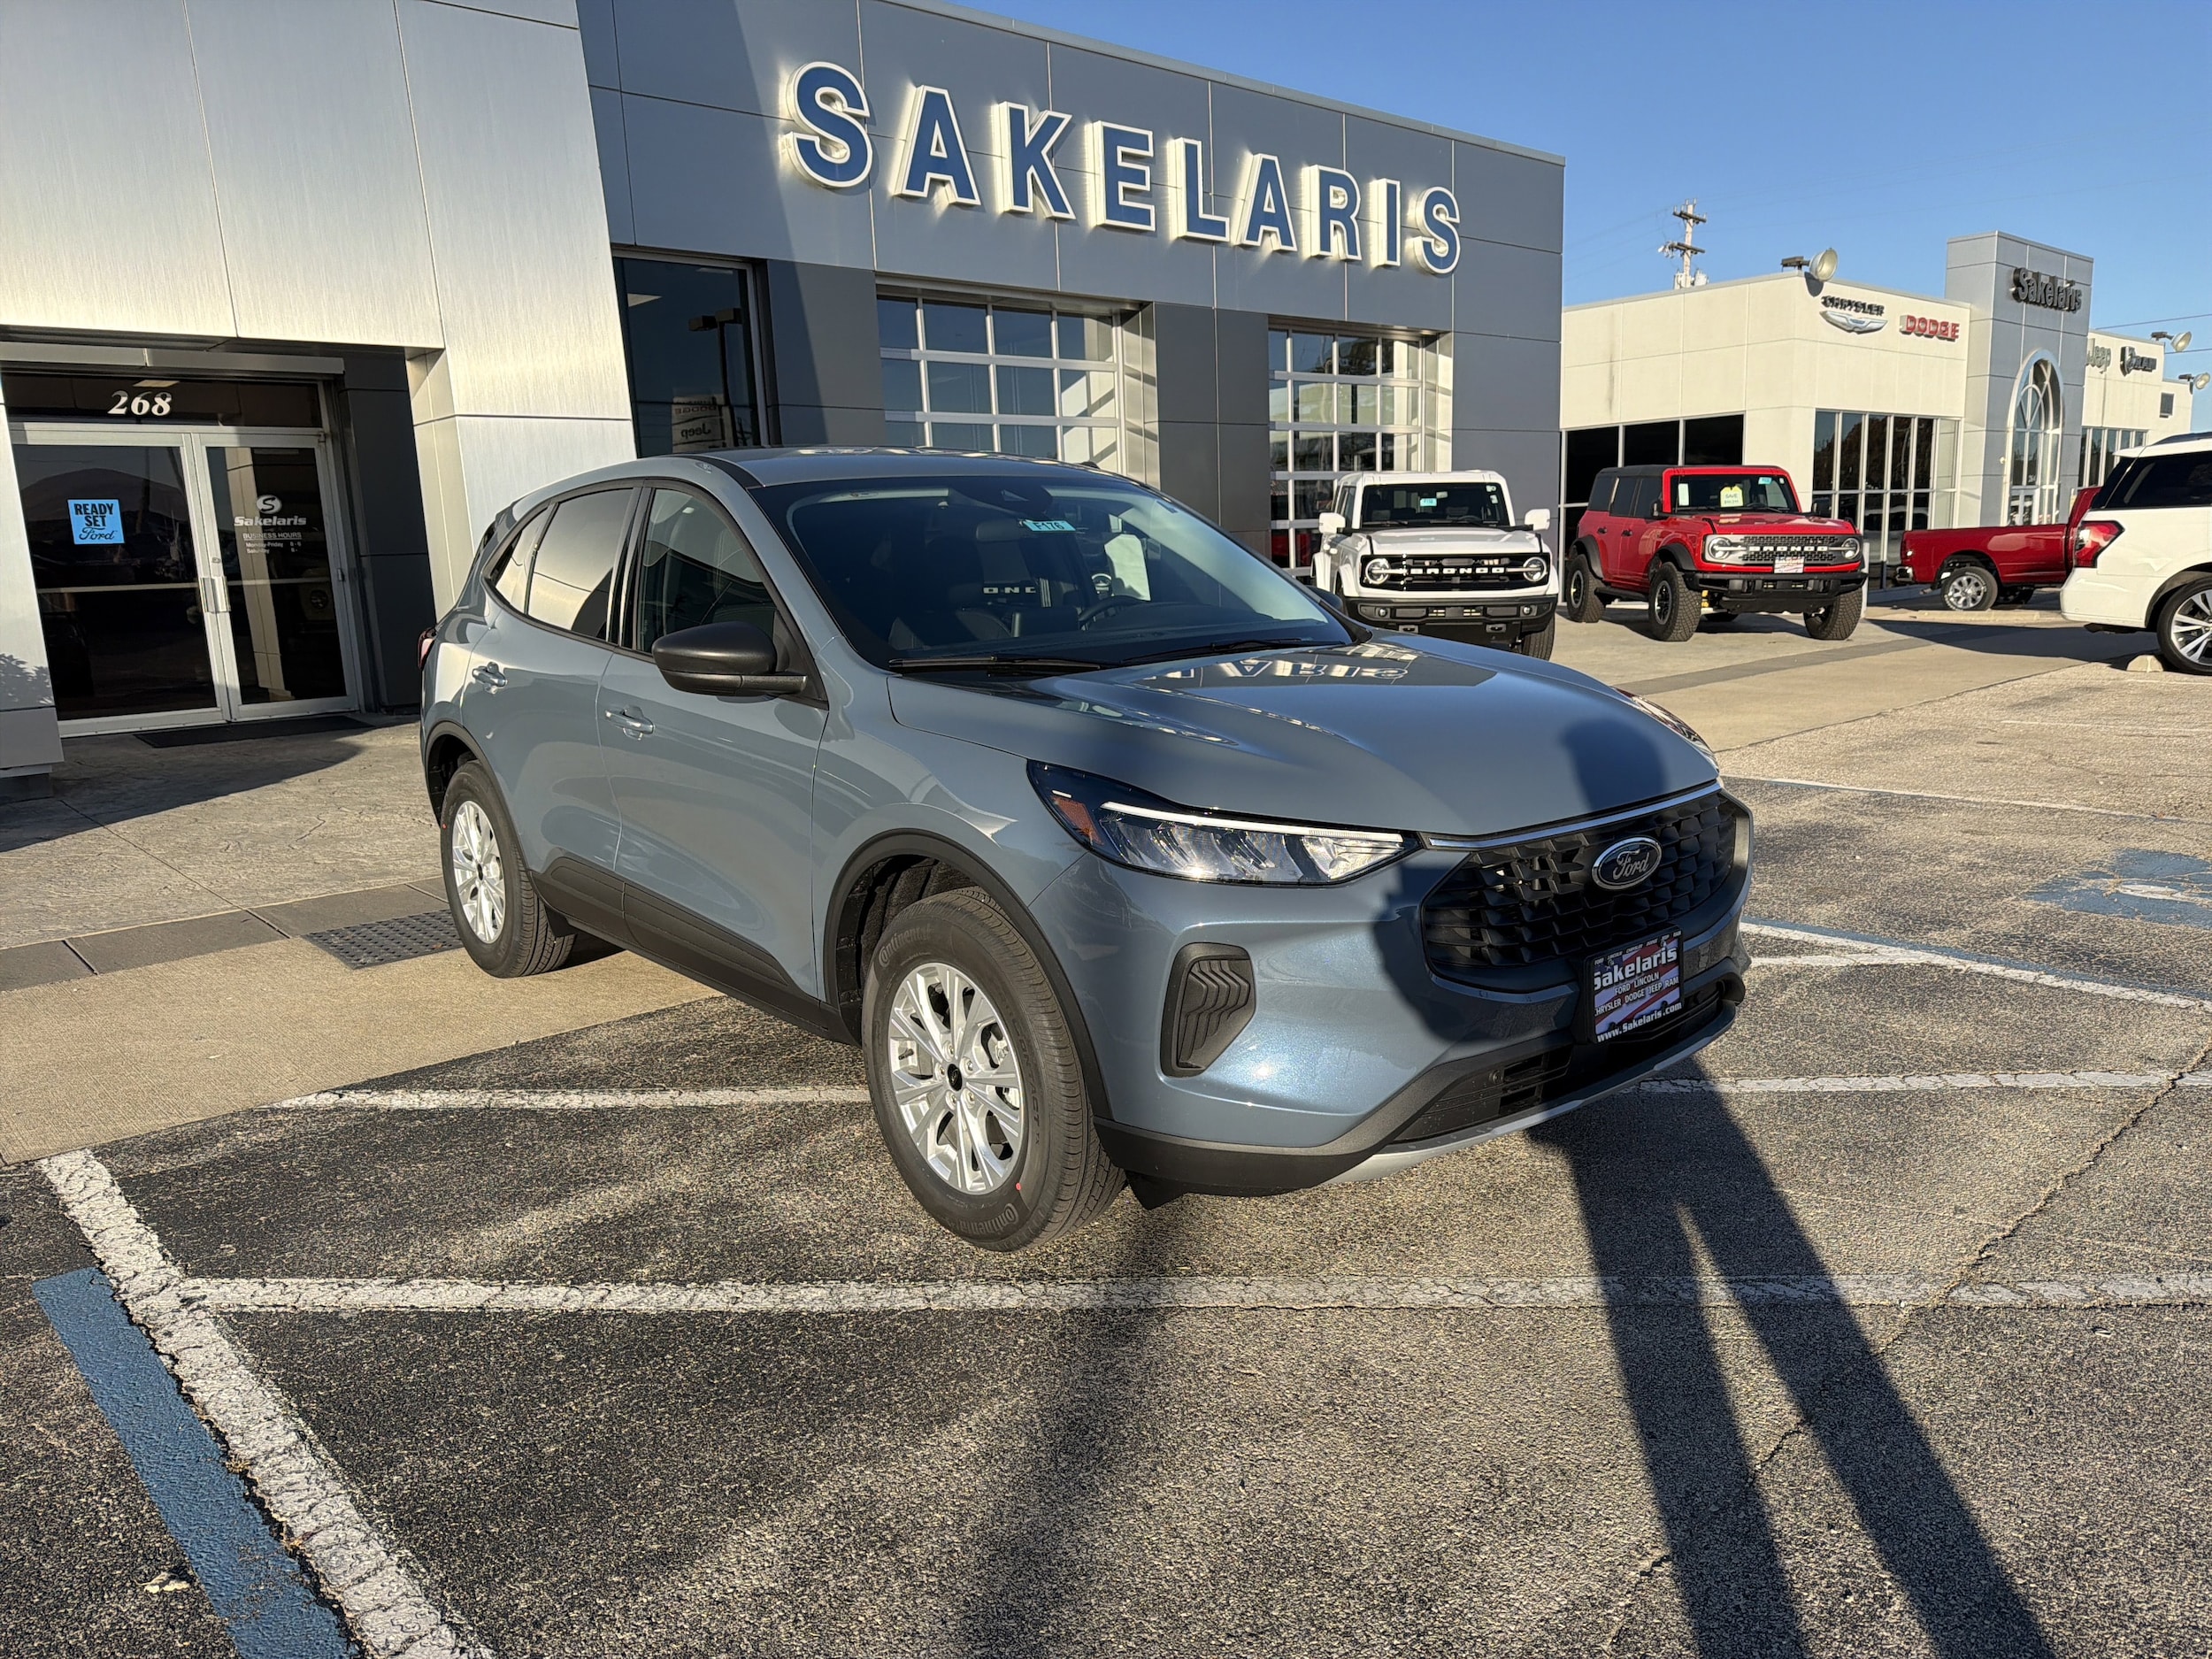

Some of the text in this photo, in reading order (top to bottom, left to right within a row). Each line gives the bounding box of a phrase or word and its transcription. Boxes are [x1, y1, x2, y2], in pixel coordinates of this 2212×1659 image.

[784, 60, 1462, 275] SAKELARIS
[2014, 267, 2082, 313] Sakelaris
[1821, 296, 1885, 316] CHRYSLER
[1901, 315, 1960, 341] DODGE
[107, 390, 172, 416] 268
[73, 503, 113, 515] READY
[84, 515, 106, 526] SET
[234, 515, 307, 526] Sakelaris
[79, 526, 115, 540] Ford
[1612, 849, 1650, 880] Ford
[1594, 947, 1678, 990] Sakelaris
[1615, 972, 1660, 995] FORD LINCOLN
[1624, 989, 1645, 1003] DODGE
[1647, 982, 1663, 994] JEEP
[1664, 977, 1679, 987] RAM
[1597, 1002, 1682, 1042] www.Sakelaris.com
